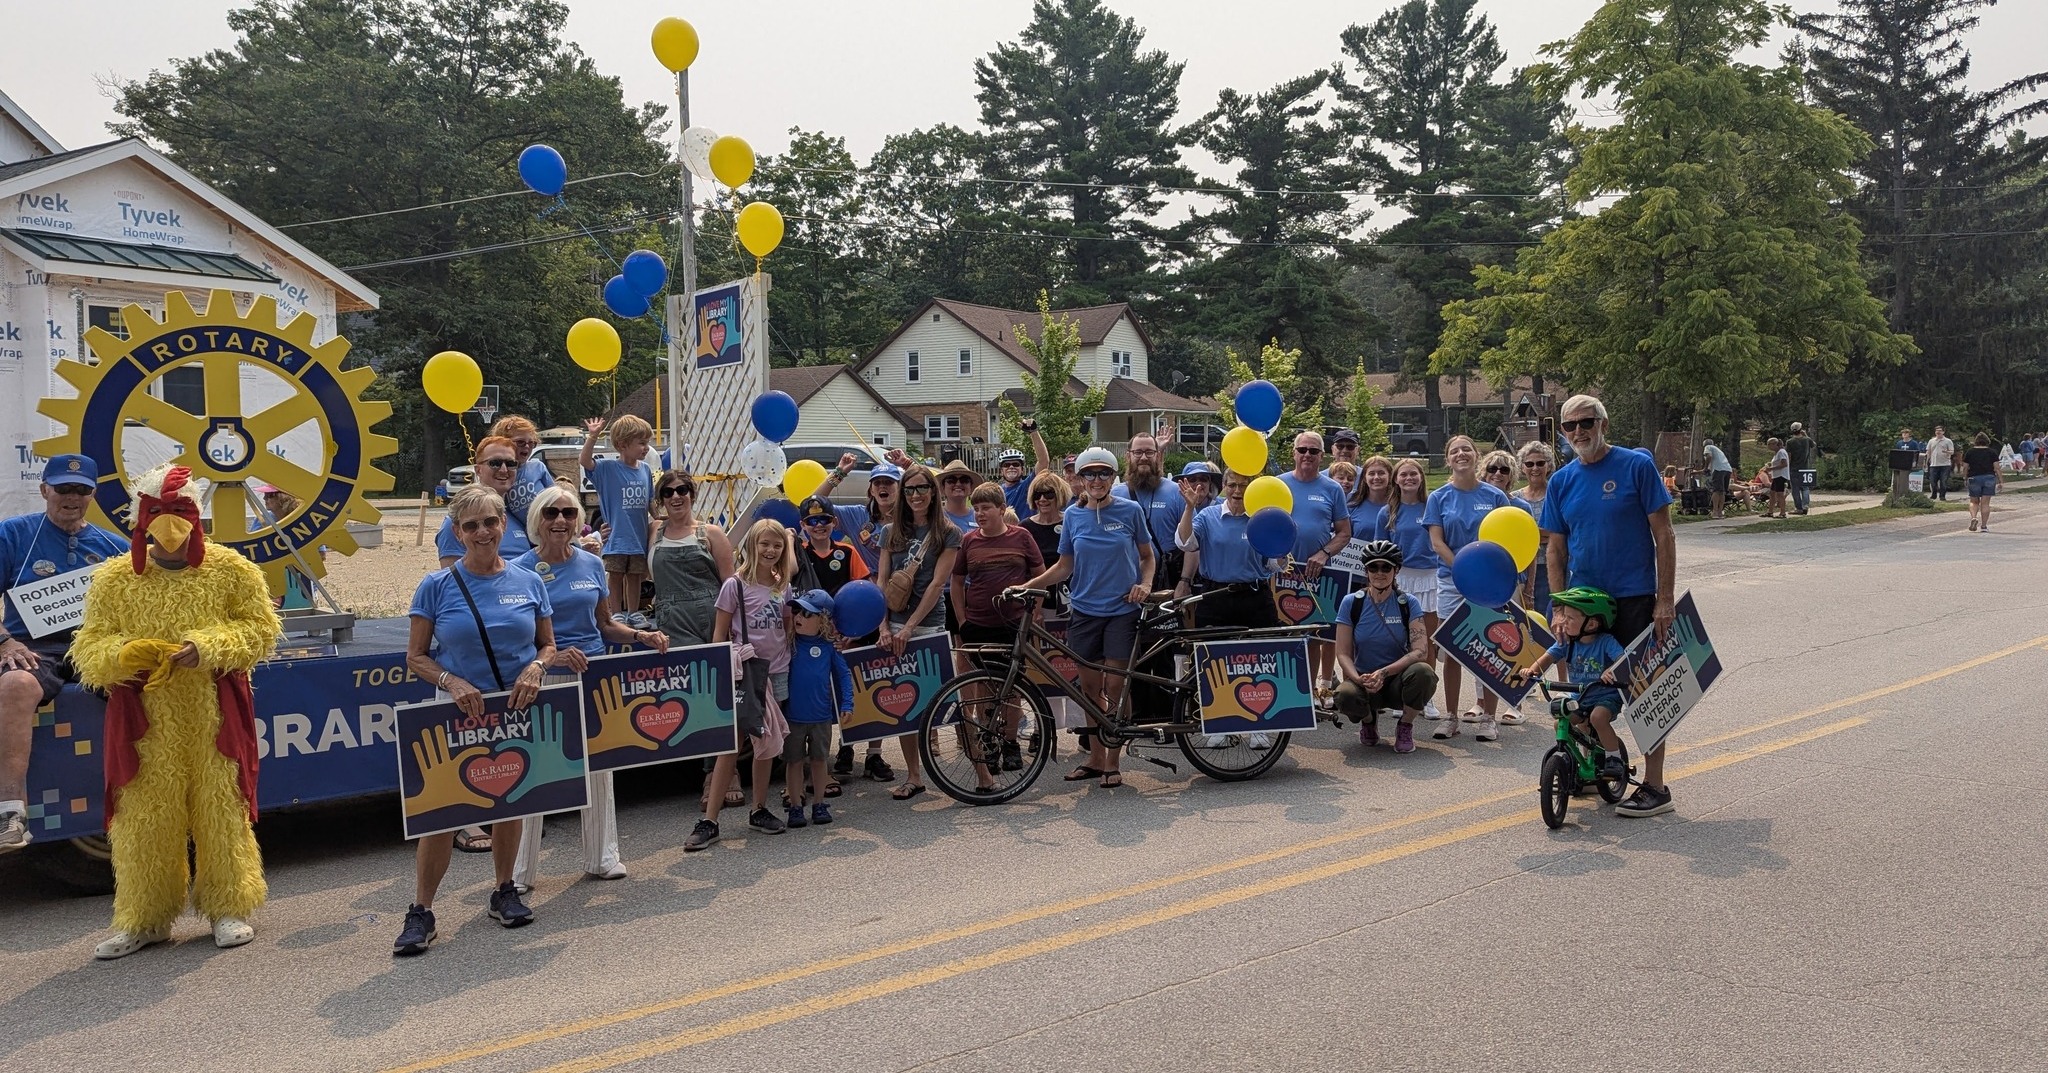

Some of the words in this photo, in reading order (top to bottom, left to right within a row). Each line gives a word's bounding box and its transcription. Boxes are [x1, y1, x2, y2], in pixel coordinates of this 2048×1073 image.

[706, 307, 728, 320] LIBRARY
[151, 331, 293, 364] ROTARY
[1802, 472, 1813, 484] 16
[1331, 557, 1354, 569] Water
[20, 578, 77, 604] ROTARY
[1275, 578, 1321, 593] LIBRARY
[43, 608, 83, 627] Water
[866, 656, 897, 670] LOVE
[898, 652, 916, 664] MY
[1231, 654, 1258, 665] LOVE
[1260, 653, 1276, 663] MY
[1468, 639, 1512, 676] LIBRARY
[1641, 633, 1681, 679] LIBRARY
[627, 666, 665, 683] LOVE
[668, 663, 690, 677] MY
[862, 661, 918, 682] LIBRARY
[1226, 662, 1277, 676] LIBRARY
[621, 675, 691, 697] LIBRARY
[1630, 696, 1653, 723] HIGH
[1651, 664, 1688, 702] SCHOOL
[1643, 682, 1684, 727] INTERACT
[454, 713, 500, 732] LOVE
[504, 708, 530, 724] MY
[640, 715, 655, 724] ELK
[655, 711, 681, 721] RAPIDS
[1657, 702, 1681, 729] CLUB
[447, 721, 532, 749] LIBRARY
[470, 767, 488, 778] ELK
[489, 762, 520, 775] RAPIDS
